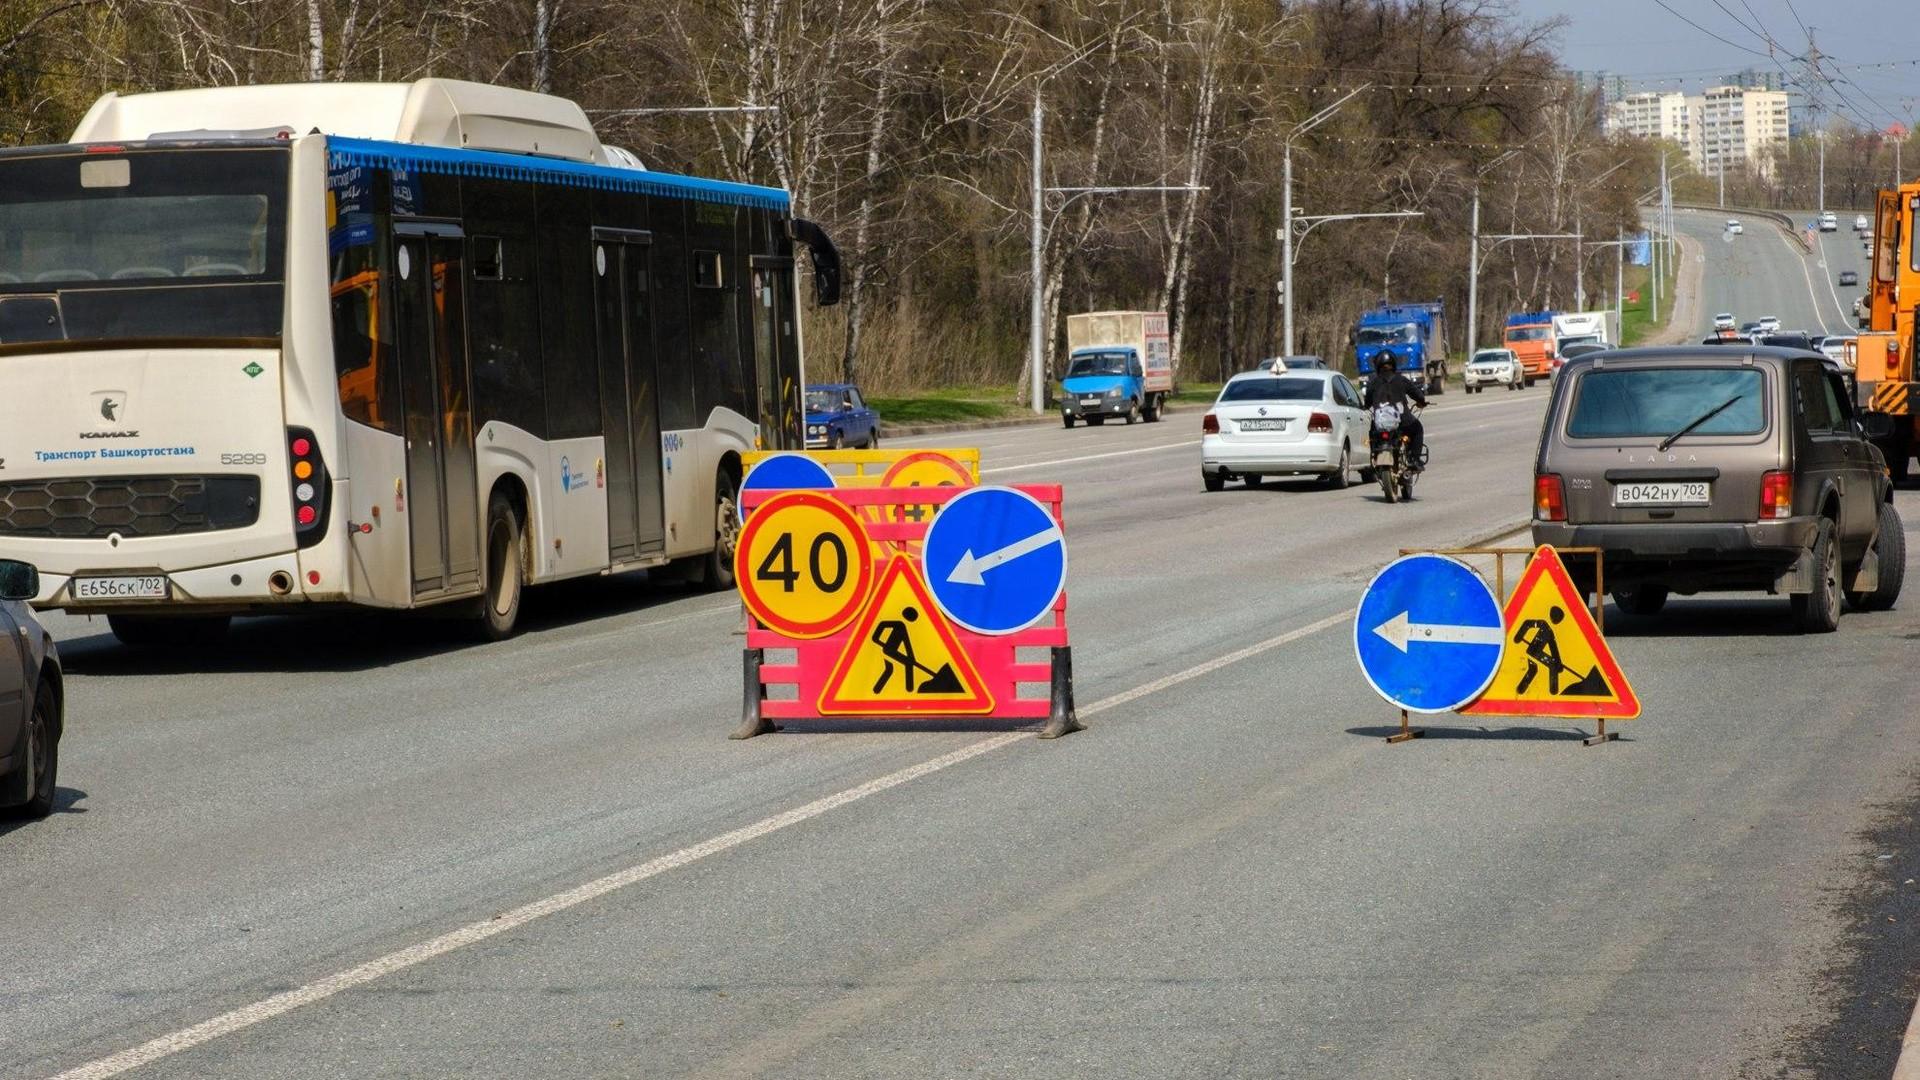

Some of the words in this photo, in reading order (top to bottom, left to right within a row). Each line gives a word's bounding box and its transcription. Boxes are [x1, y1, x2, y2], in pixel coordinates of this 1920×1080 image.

[35, 450, 96, 461] Транспорт
[101, 446, 195, 458] Башкортостана
[221, 453, 266, 464] 5299
[1629, 455, 1697, 463] LADA
[1622, 486, 1679, 500] В042НУ
[1683, 485, 1705, 496] 702
[757, 532, 848, 593] 40
[81, 581, 135, 595] Е656СК
[139, 579, 160, 589] 702
